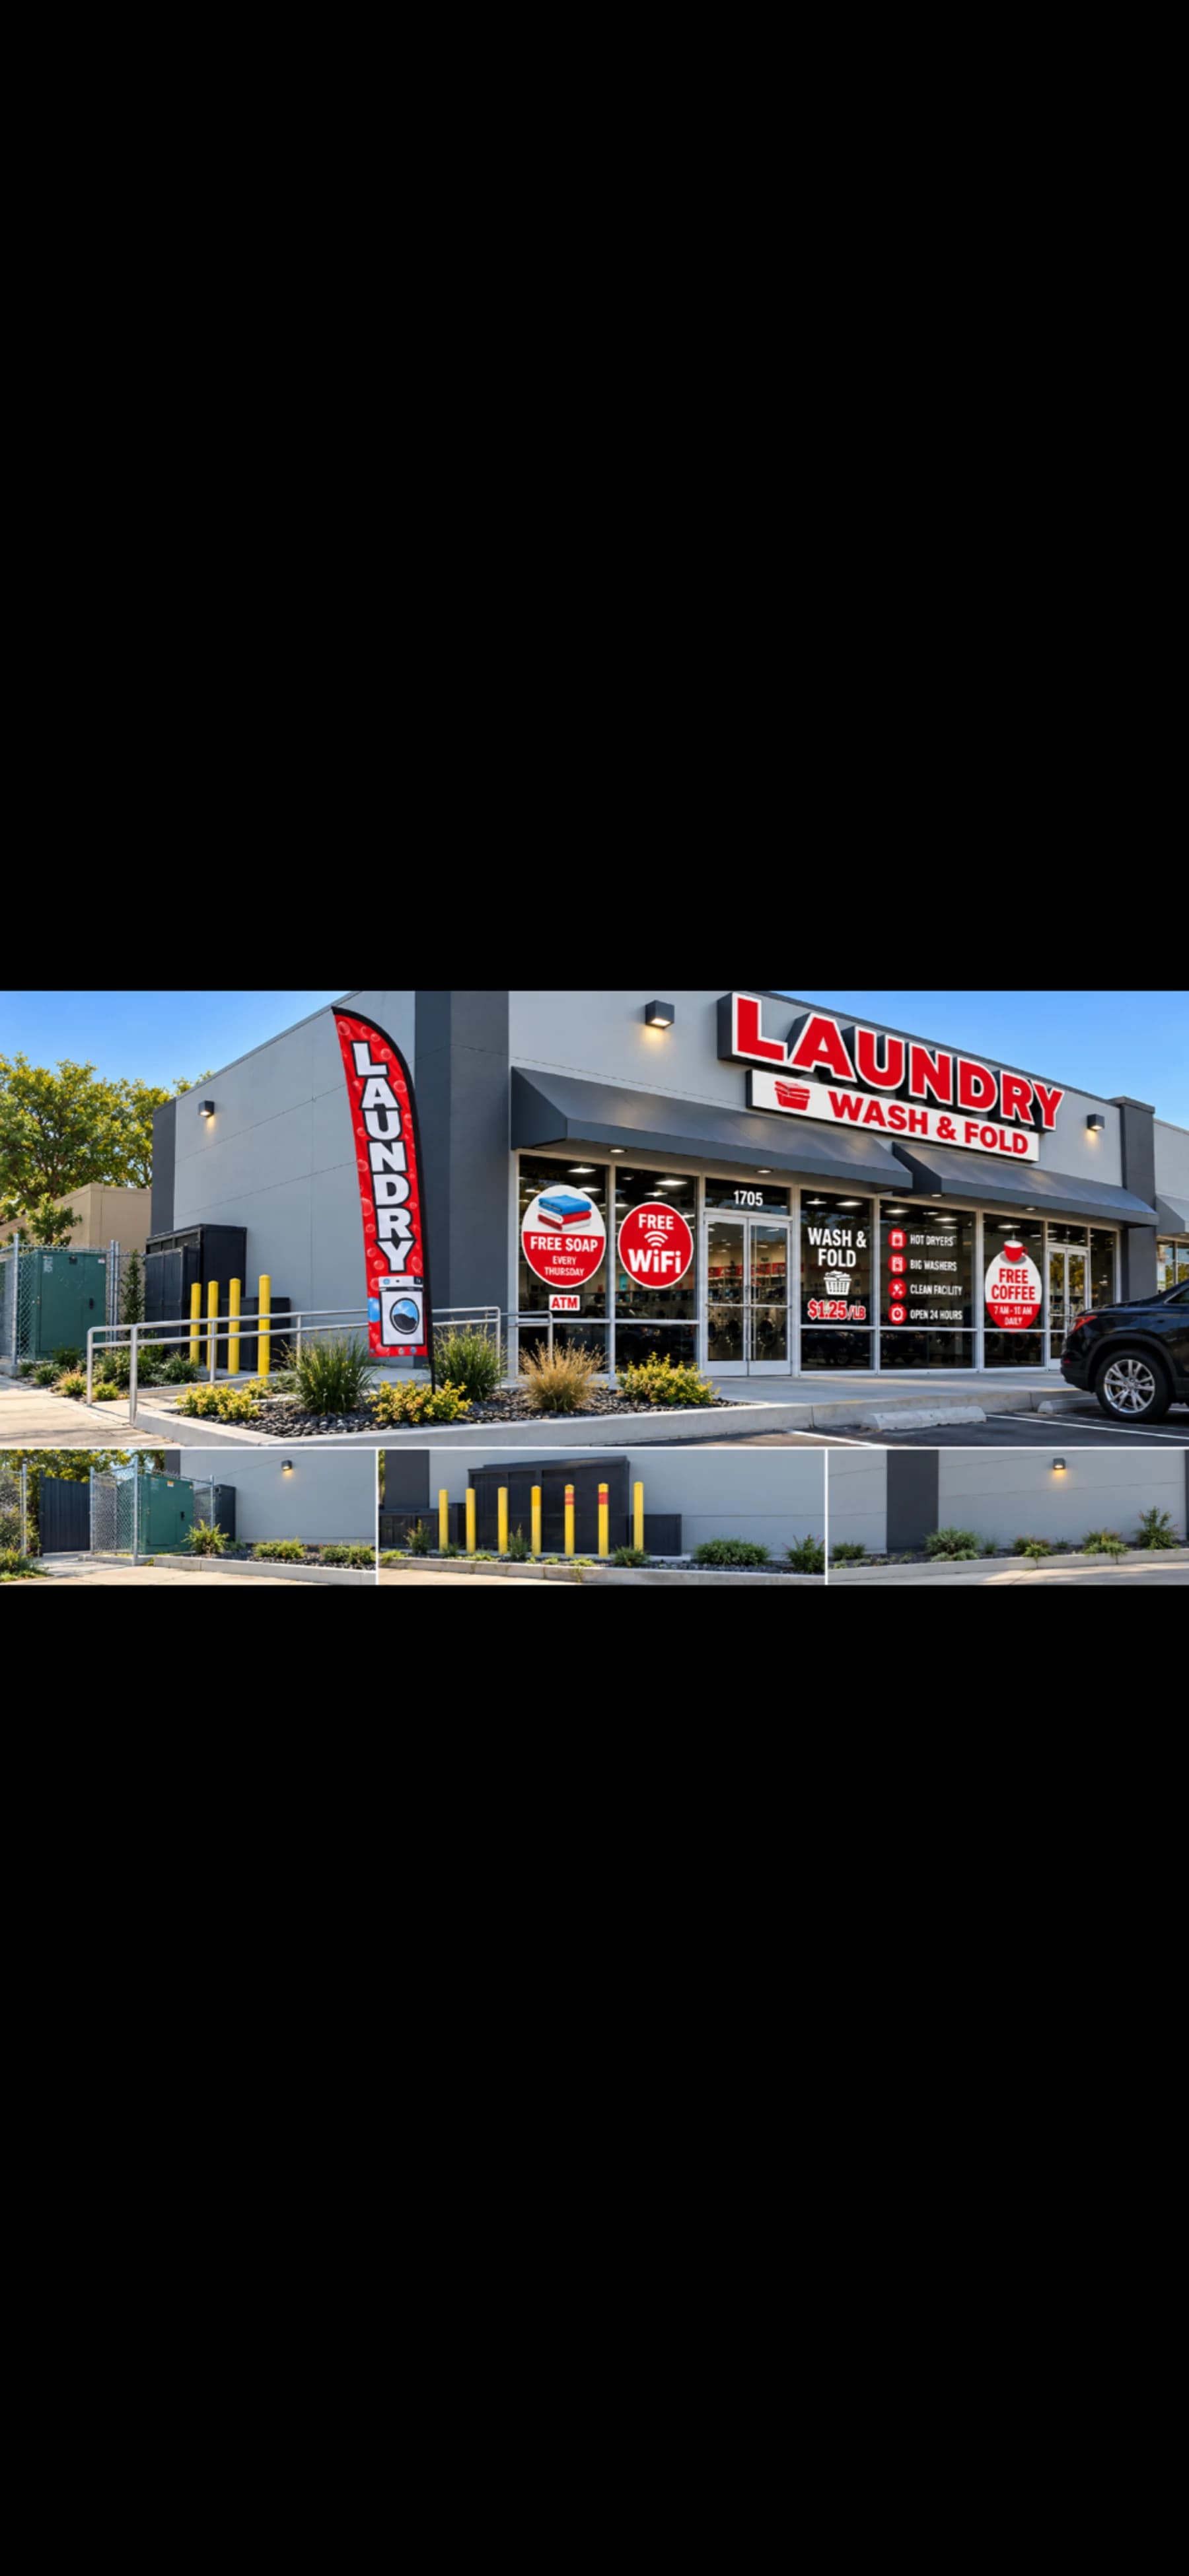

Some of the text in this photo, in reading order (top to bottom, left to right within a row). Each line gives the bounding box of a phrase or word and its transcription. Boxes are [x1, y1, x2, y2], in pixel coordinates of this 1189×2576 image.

[732, 992, 1065, 1131] LAUNDRY
[828, 1091, 1028, 1154] WASH & FOLD
[350, 1040, 416, 1272] LAUNDRY
[734, 1190, 763, 1206] 1705
[638, 1213, 674, 1230] FREE
[530, 1236, 598, 1252] FREE SOAP
[807, 1227, 867, 1248] WASH &
[910, 1234, 954, 1247] HOT DRYERS
[552, 1255, 577, 1265] EVERY
[628, 1249, 681, 1274] WiFi
[818, 1248, 856, 1267] FOLD
[910, 1259, 957, 1272] BIG WASHERS
[544, 1267, 585, 1276] THURSDAY
[999, 1268, 1028, 1284] FREE
[910, 1284, 962, 1296] CLEAN FACILITY
[991, 1284, 1035, 1300] COFFEE
[552, 1296, 578, 1309] ATM
[994, 1305, 998, 1315] 7
[999, 1306, 1009, 1315] AM
[1023, 1306, 1032, 1315] AM
[910, 1309, 962, 1320] OPEN 24 HOURS
[1004, 1317, 1023, 1325] DAILY
